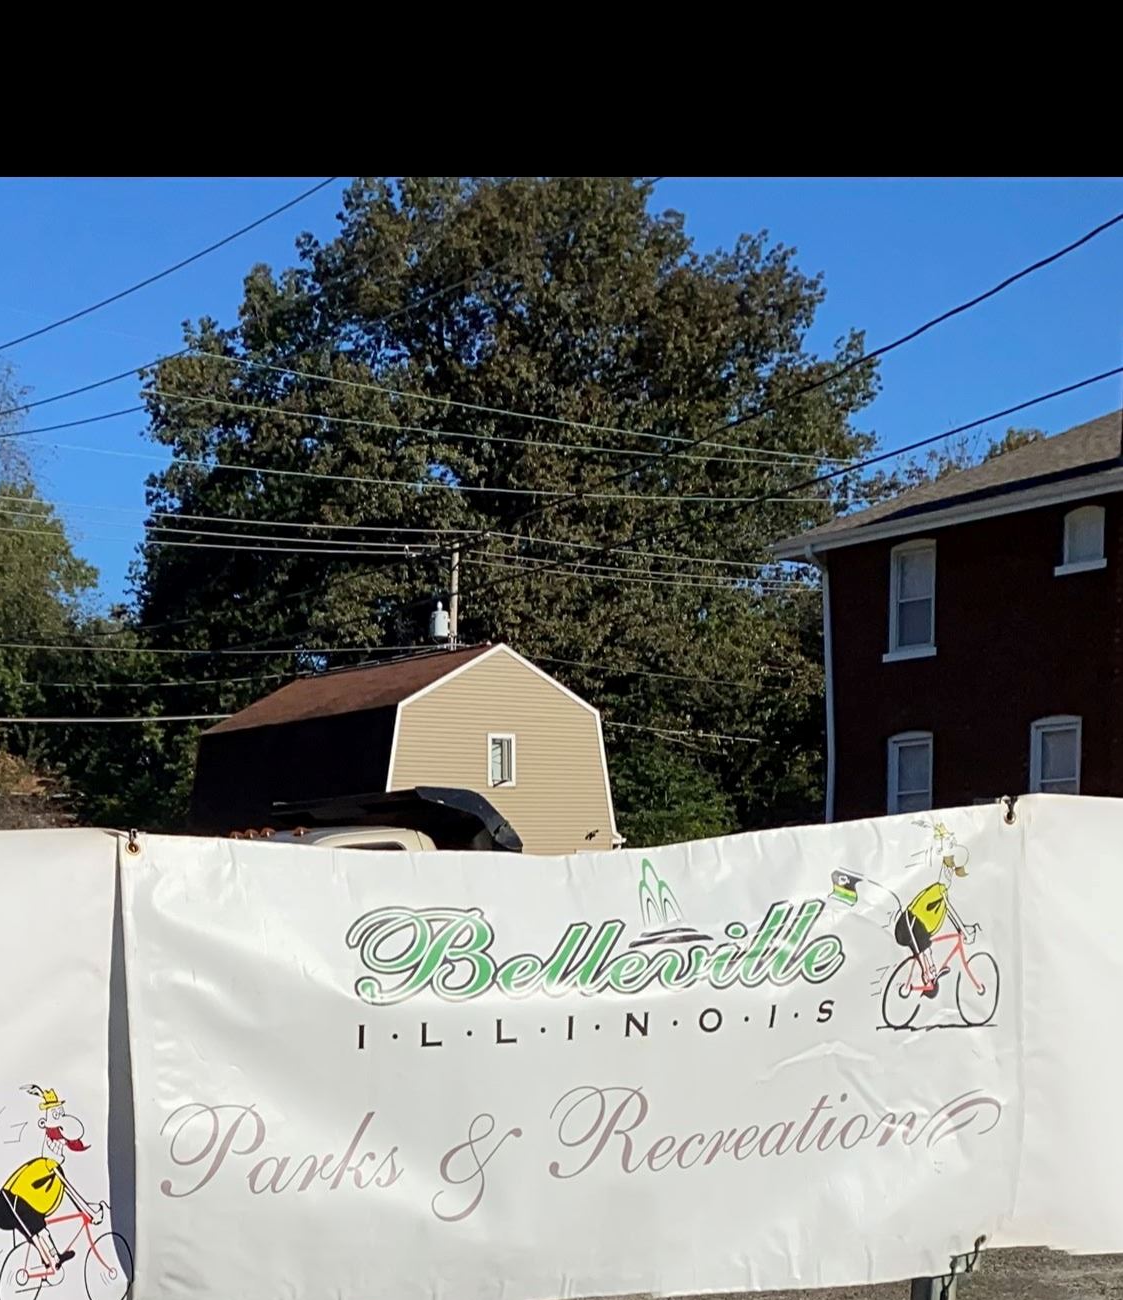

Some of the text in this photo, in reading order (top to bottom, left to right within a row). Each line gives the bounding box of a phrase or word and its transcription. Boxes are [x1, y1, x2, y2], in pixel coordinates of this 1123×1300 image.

[346, 897, 845, 1006] Belleville
[159, 1085, 922, 1222] Parks & Recreation
